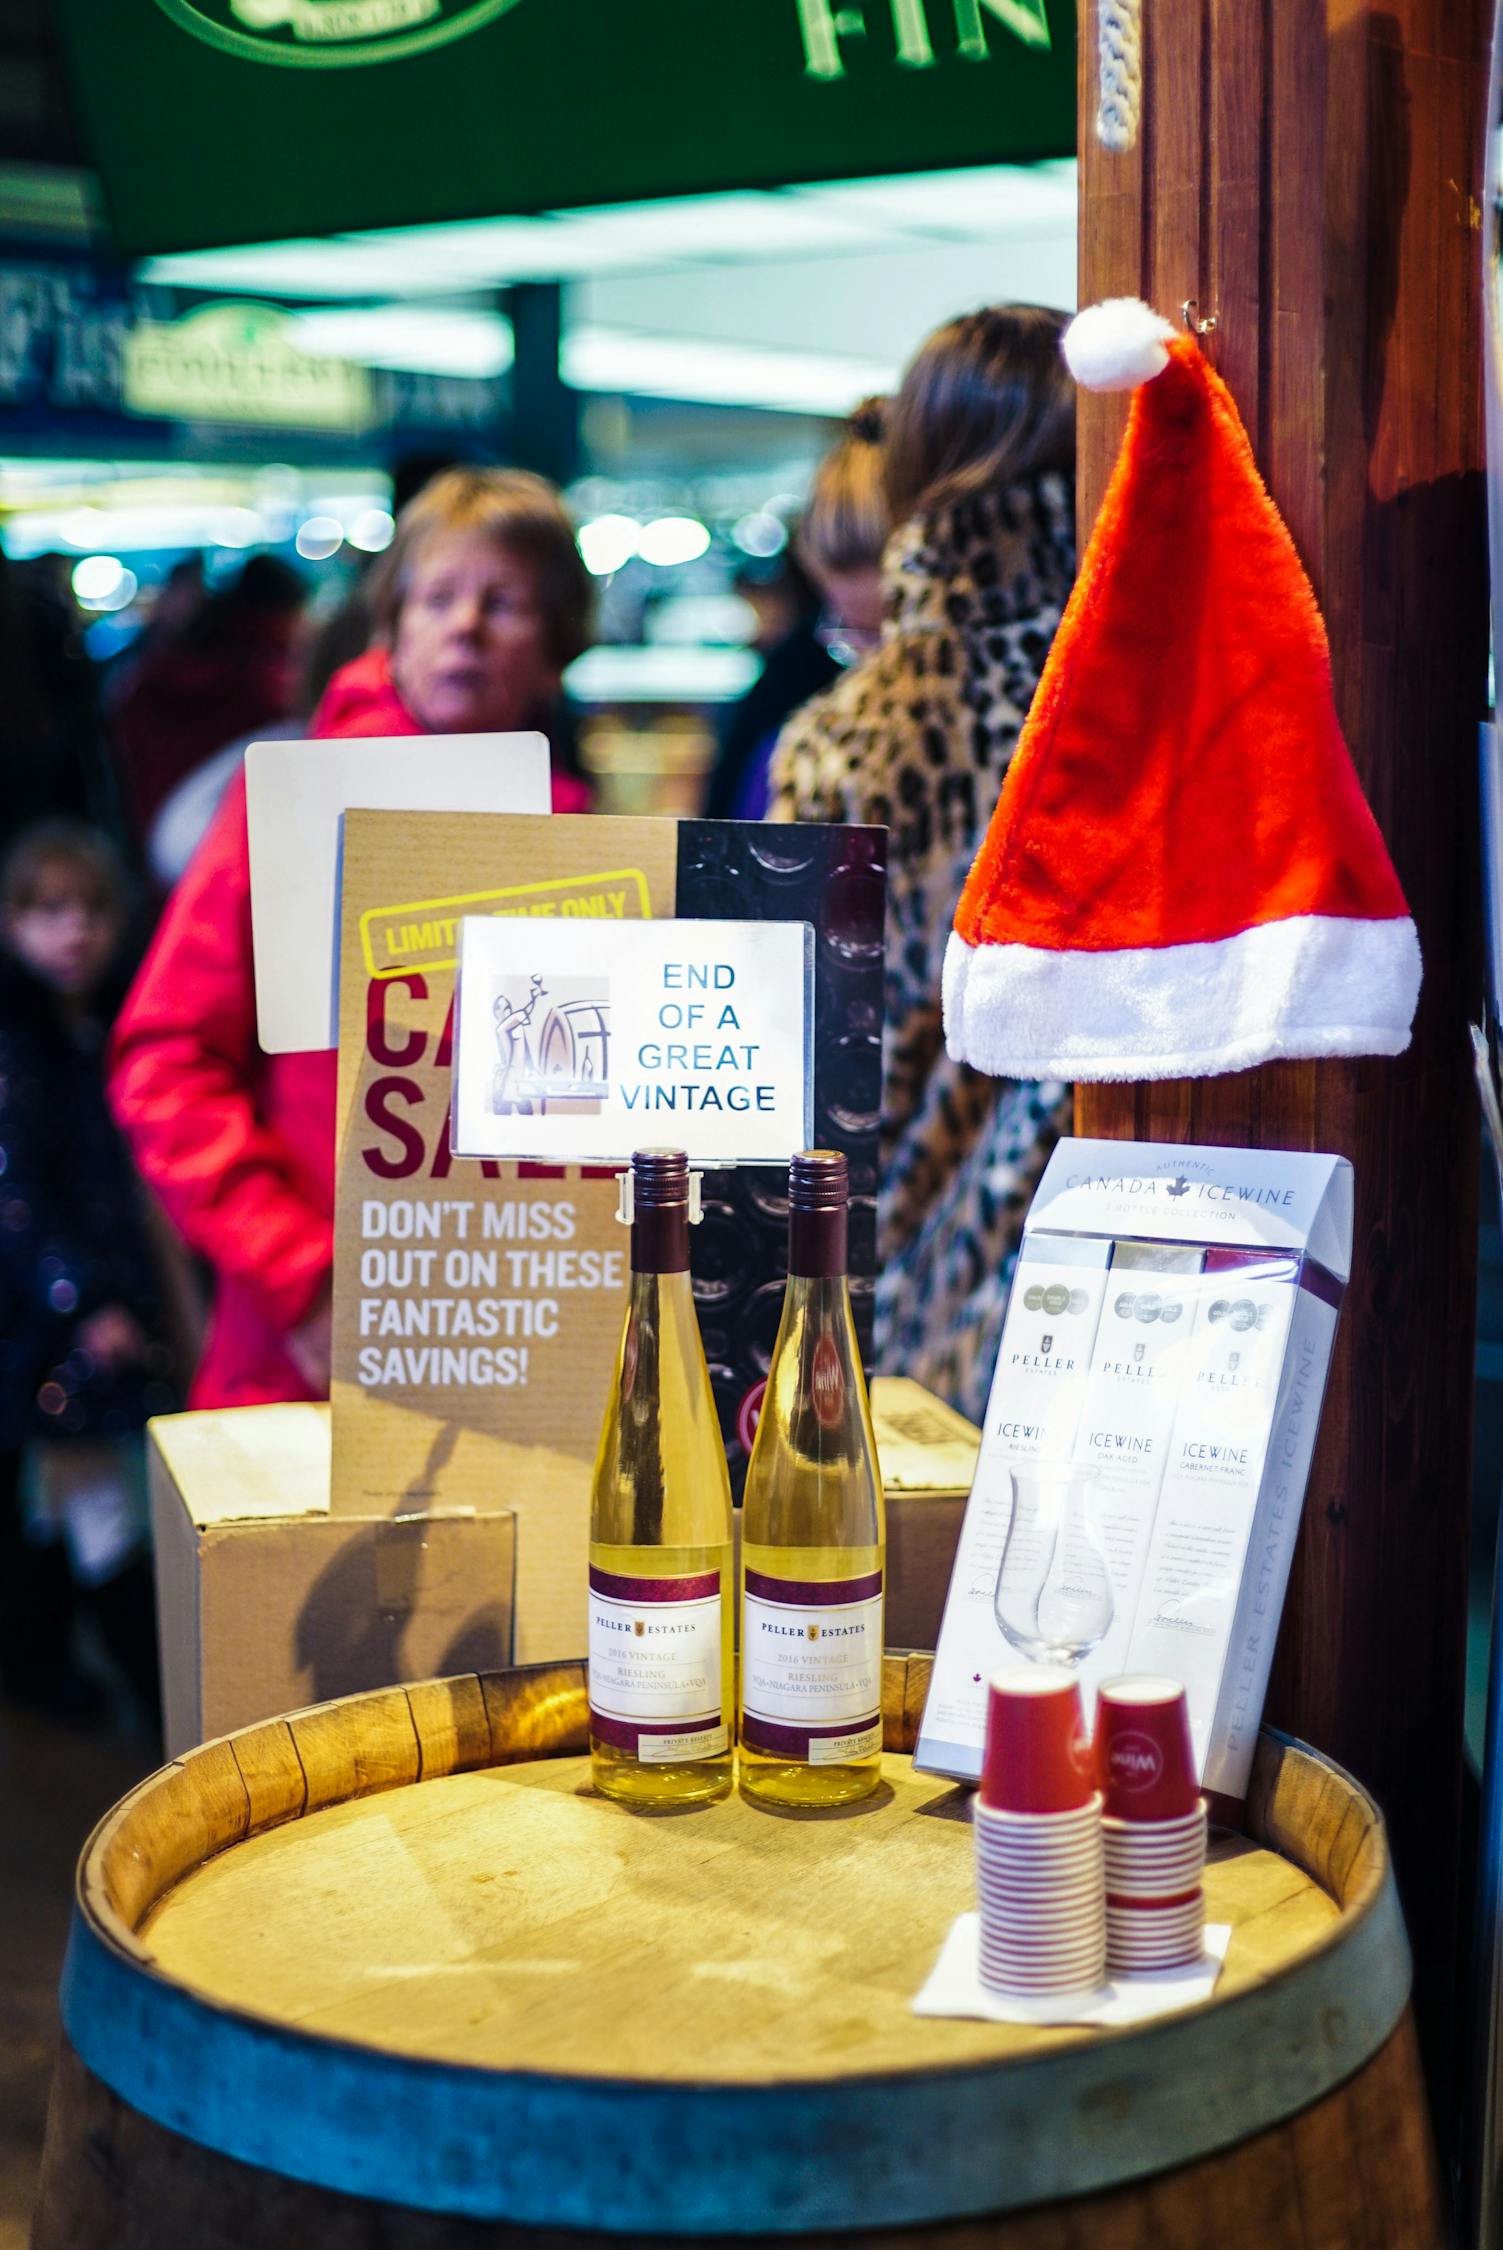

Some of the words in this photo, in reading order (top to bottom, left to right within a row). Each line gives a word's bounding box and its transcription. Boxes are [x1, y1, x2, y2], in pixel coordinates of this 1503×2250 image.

[664, 964, 735, 989] END
[659, 1004, 705, 1029] OF
[717, 1005, 741, 1030] A
[638, 1044, 760, 1070] GREAT
[620, 1085, 775, 1111] VINTAGE
[1066, 1174, 1157, 1195] CANADA
[1198, 1183, 1296, 1206] ICEWINE
[361, 1200, 474, 1240] DON'T
[483, 1201, 576, 1240] MISS
[1163, 1207, 1236, 1221] COLLECTION
[360, 1249, 437, 1289] OUT
[445, 1249, 497, 1289] ON
[506, 1250, 624, 1289] THESE
[360, 1298, 559, 1337] FANTASTIC
[358, 1346, 528, 1386] SAVINGS!
[1011, 1353, 1075, 1371] PELLER
[1089, 1432, 1152, 1453] ICEWINE
[1183, 1443, 1248, 1464] ICEWINE
[1227, 1634, 1260, 1751] PELLER
[1254, 1485, 1288, 1617] ESTATES
[1282, 1338, 1316, 1469] ICEWINE
[596, 1616, 632, 1632] PELLER
[648, 1624, 696, 1634] ESTATES
[762, 1622, 804, 1637] PELLER
[822, 1623, 865, 1637] ESTATES
[629, 1651, 677, 1661] VINTAGE
[778, 1654, 800, 1662] 2016
[801, 1654, 849, 1665] VINTAGE
[617, 1667, 666, 1679] RIESLING
[788, 1672, 838, 1684] RIESLING
[1111, 1751, 1156, 1771] Wine
